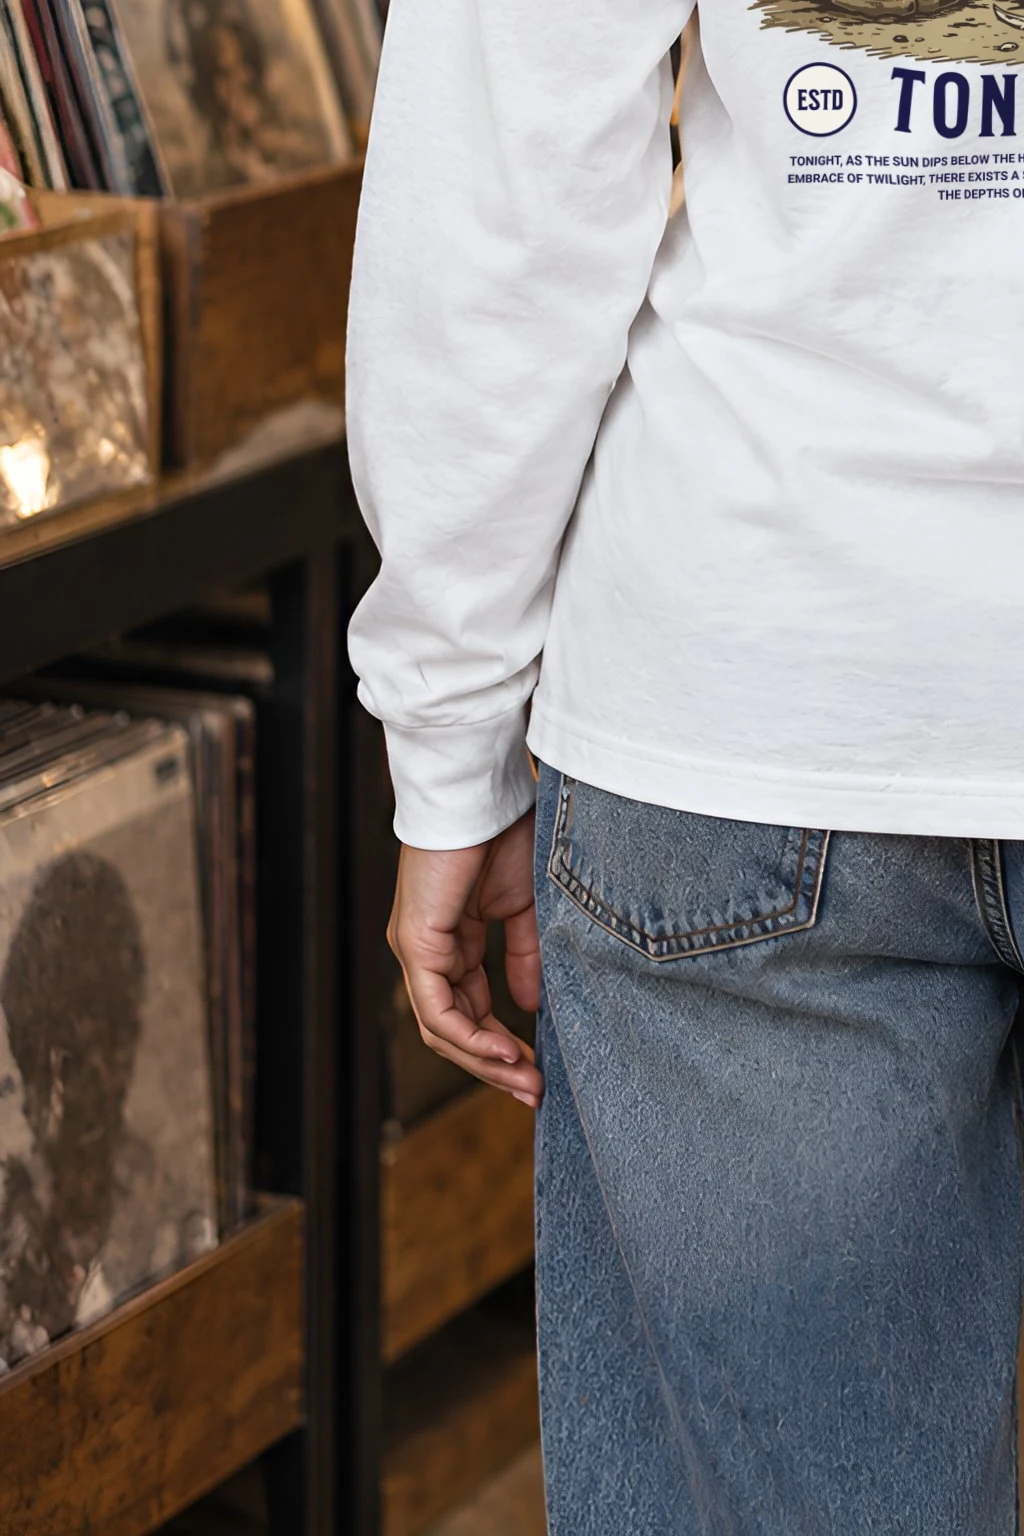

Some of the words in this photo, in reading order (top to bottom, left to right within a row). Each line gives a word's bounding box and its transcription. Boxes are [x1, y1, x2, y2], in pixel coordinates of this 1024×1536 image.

[797, 89, 843, 111] ESTD
[789, 155, 843, 167] TONIGHT,
[846, 155, 862, 166] AS
[865, 155, 890, 166] THE
[892, 156, 919, 168] SUN
[922, 156, 948, 168] DIPS
[950, 154, 990, 166] BELOW
[992, 153, 1015, 164] THE
[788, 173, 844, 184] EMBRACE
[847, 173, 863, 183] OF
[866, 174, 926, 186] TWILIGHT,
[928, 172, 965, 184] THERE
[968, 171, 1008, 182] EXISTS
[1011, 170, 1020, 180] A
[937, 189, 961, 200] THE
[964, 188, 1010, 199] DEPTHS
